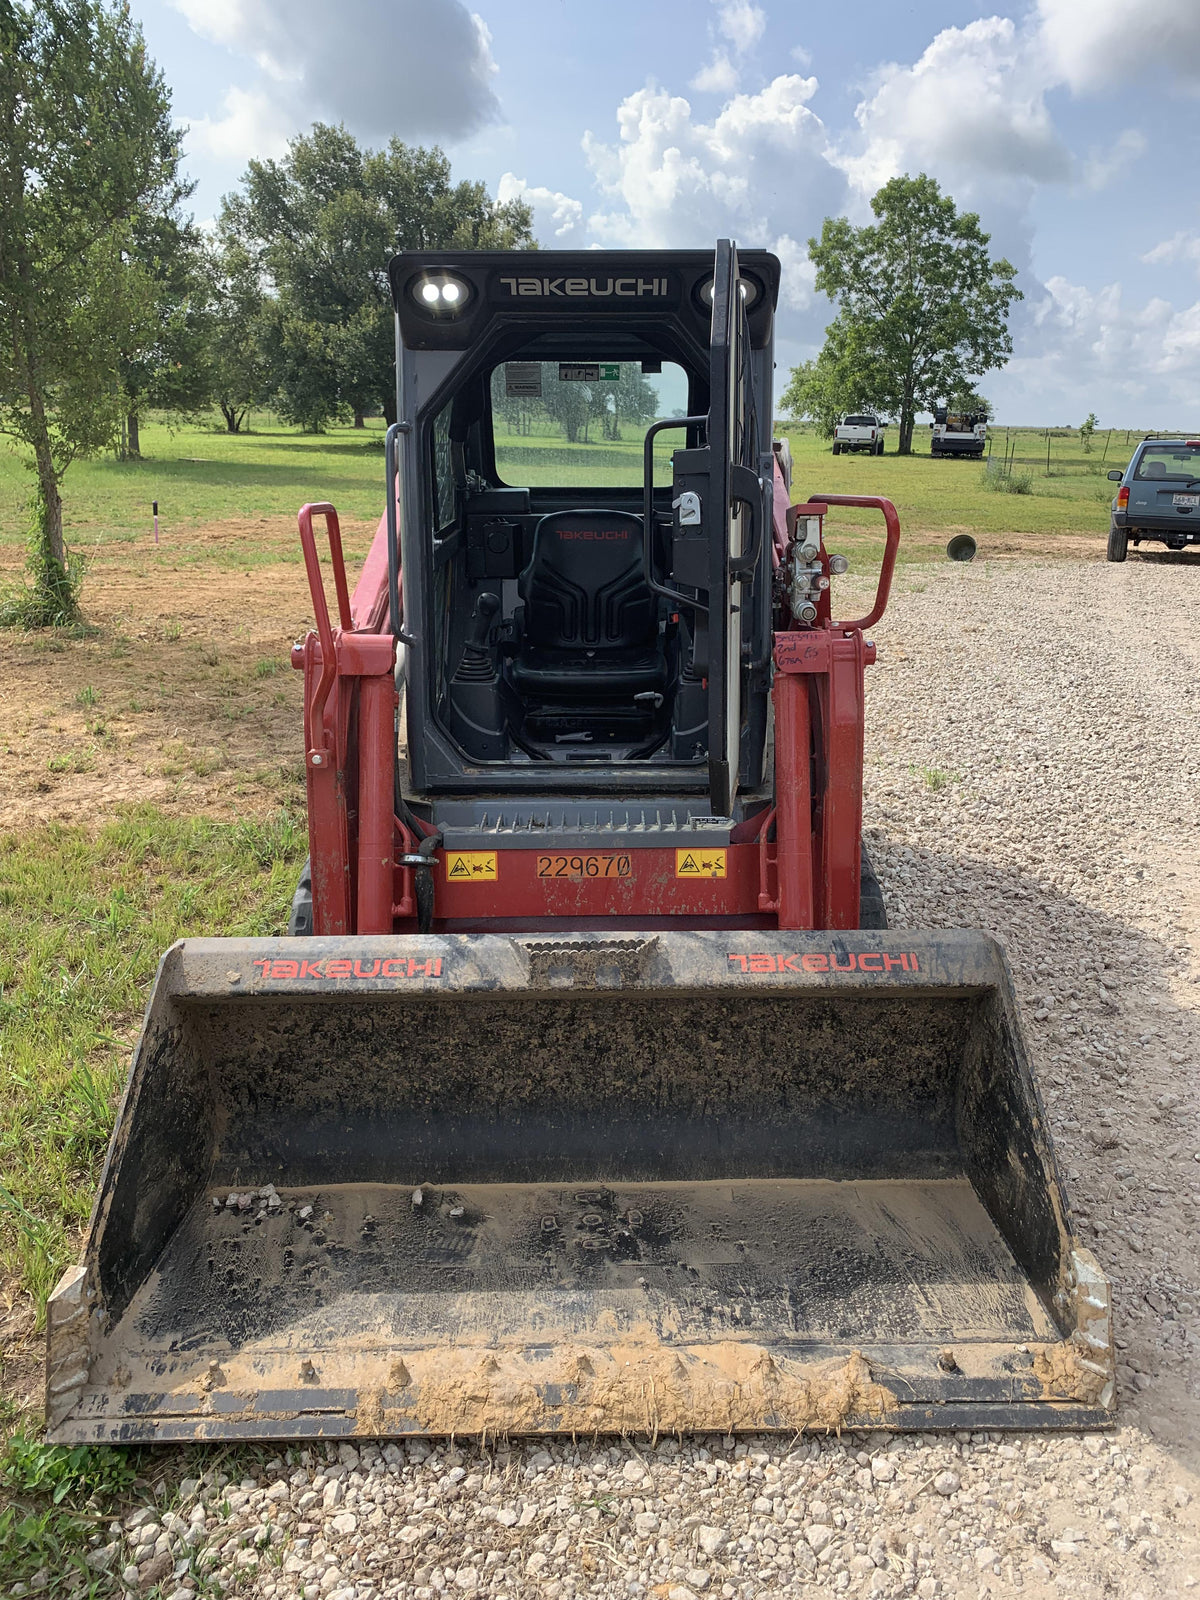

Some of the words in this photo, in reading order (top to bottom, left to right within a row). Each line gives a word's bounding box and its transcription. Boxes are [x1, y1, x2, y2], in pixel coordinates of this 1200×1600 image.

[500, 278, 668, 296] TAKEUCHI
[555, 530, 628, 540] TAKEUCHI
[539, 856, 631, 877] 229670
[253, 958, 443, 979] TAKEUCHI
[729, 953, 919, 972] TAKEUCHI
